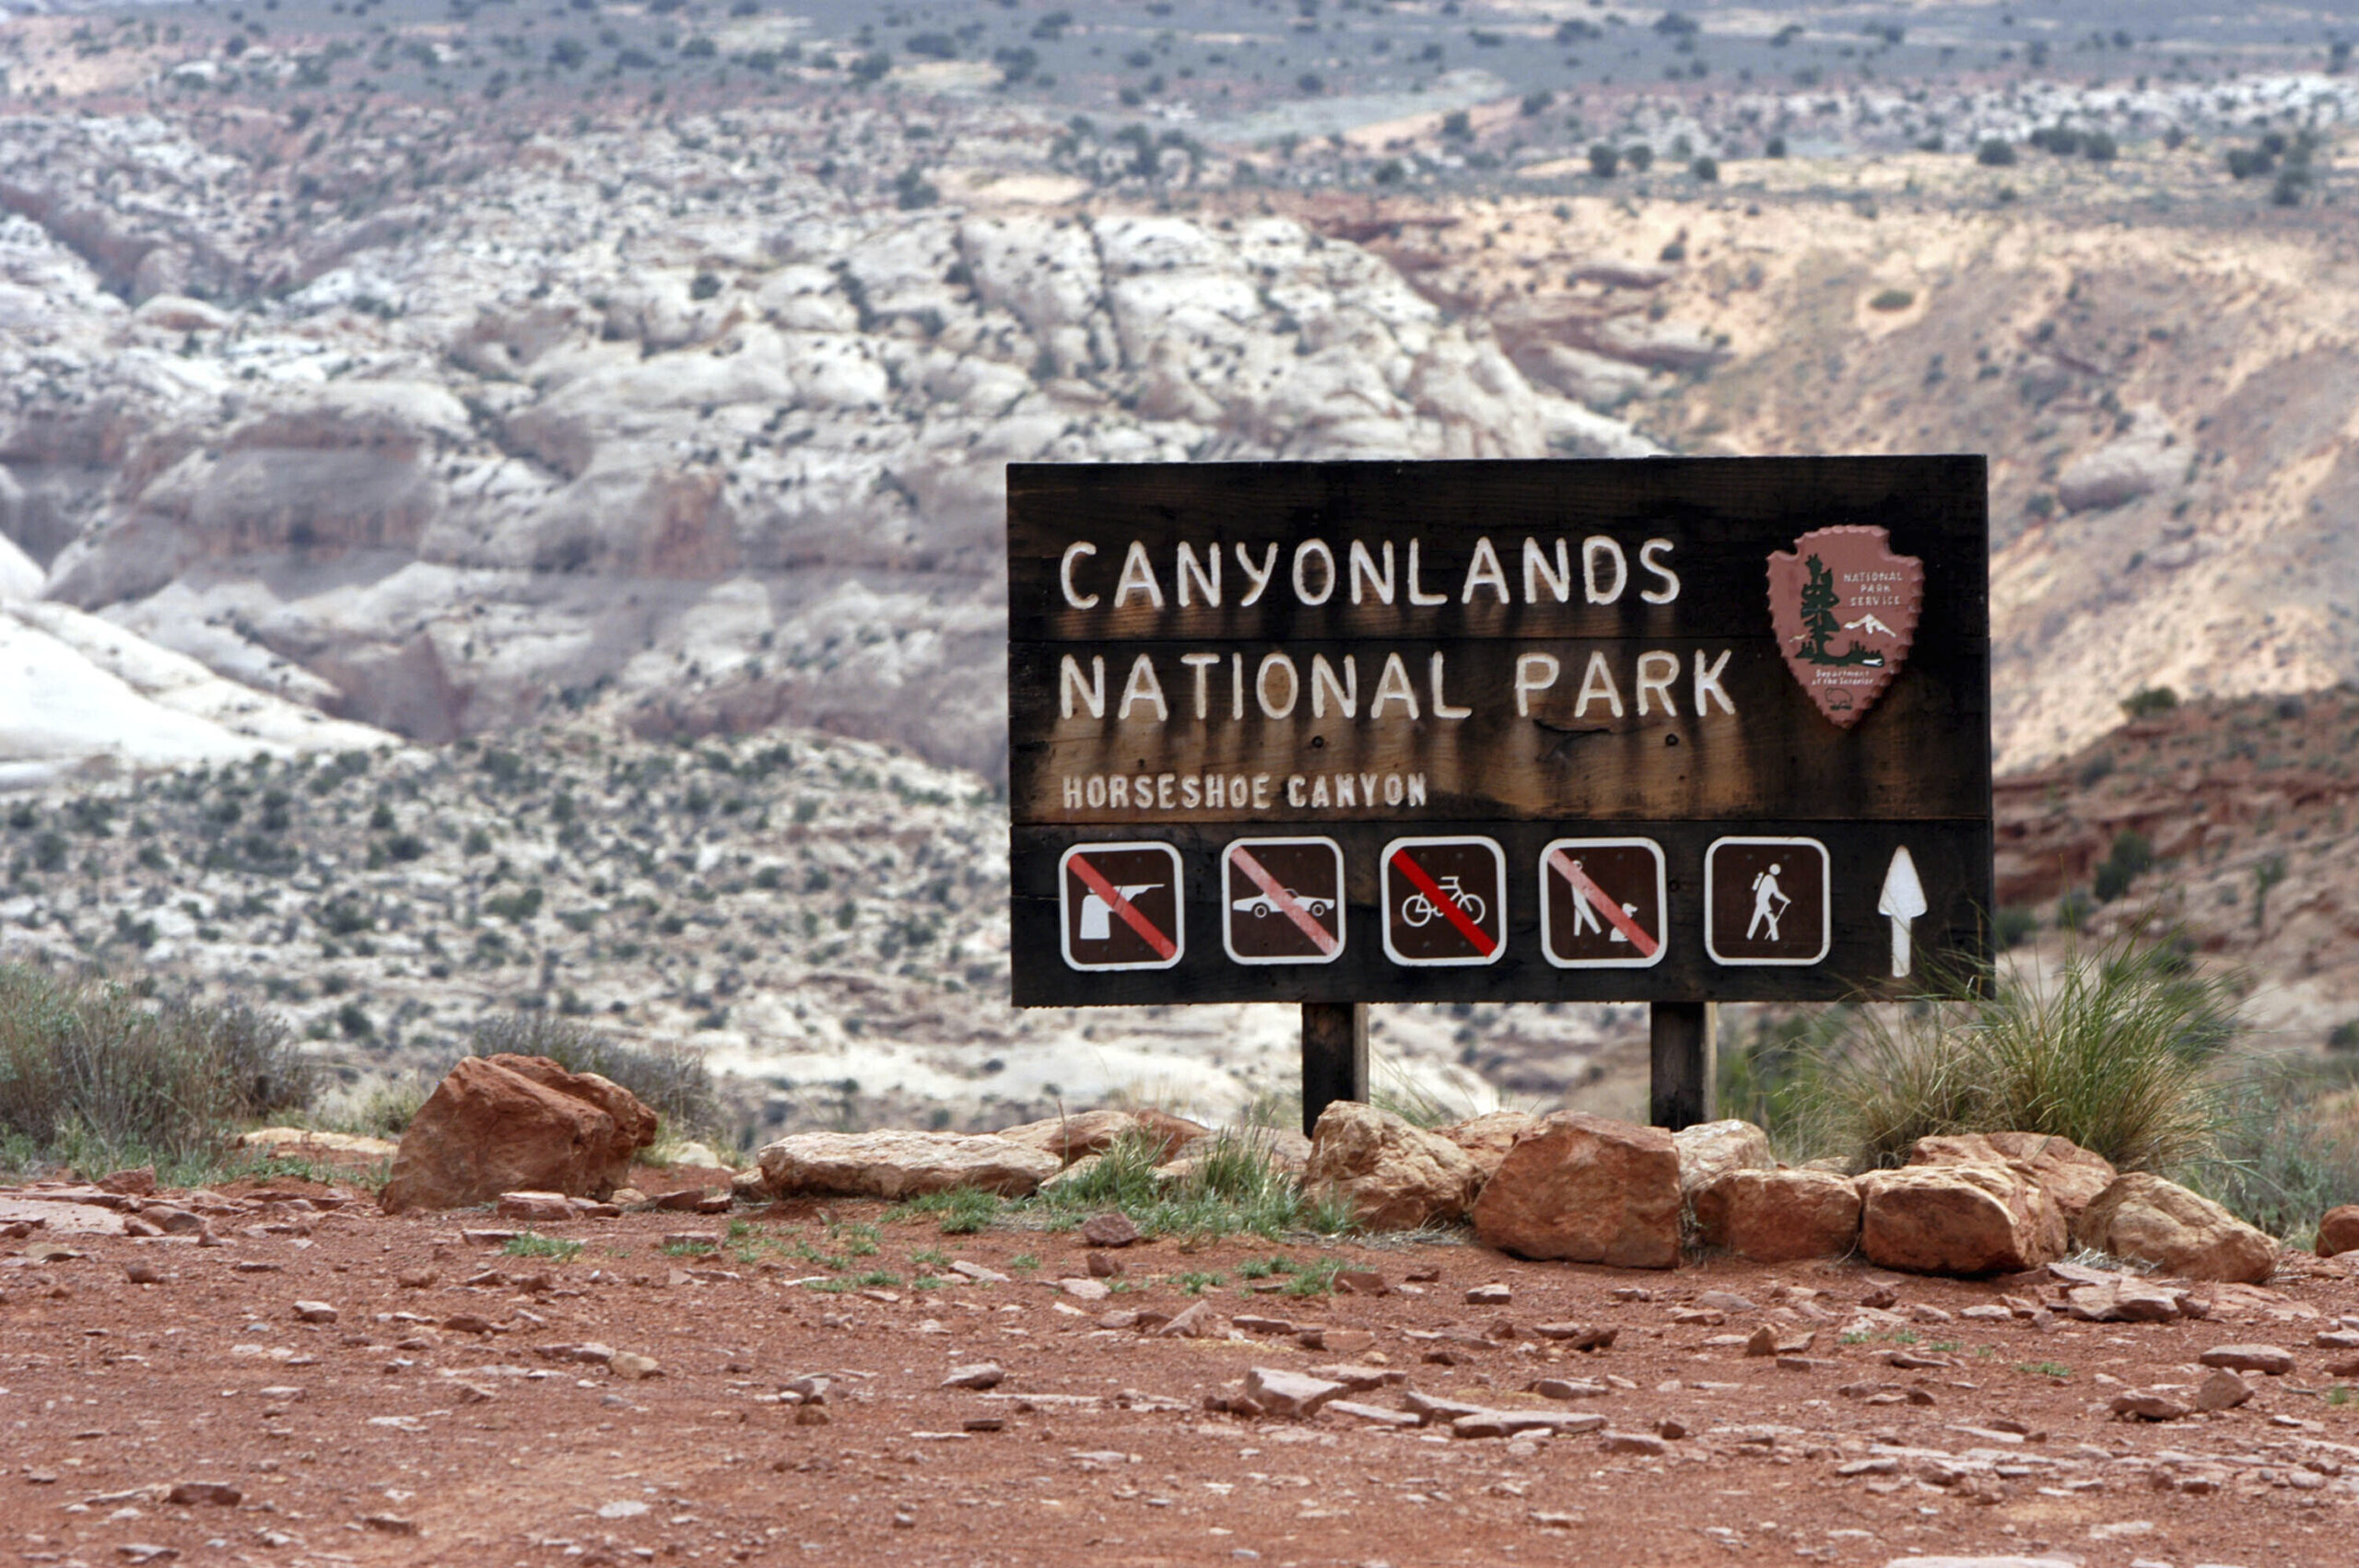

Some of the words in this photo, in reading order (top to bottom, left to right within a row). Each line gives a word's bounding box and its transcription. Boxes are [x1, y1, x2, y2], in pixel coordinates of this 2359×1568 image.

[1059, 536, 1682, 610] CANYONLANDS
[1844, 572, 1903, 582] NATIONAL
[1860, 584, 1891, 592] PARK
[1850, 597, 1901, 606] SERVICE
[1059, 651, 1473, 722] NATIONAL
[1514, 649, 1737, 719] PARK
[1062, 774, 1270, 810] HORSESHOE
[1288, 771, 1427, 808] CANYON
